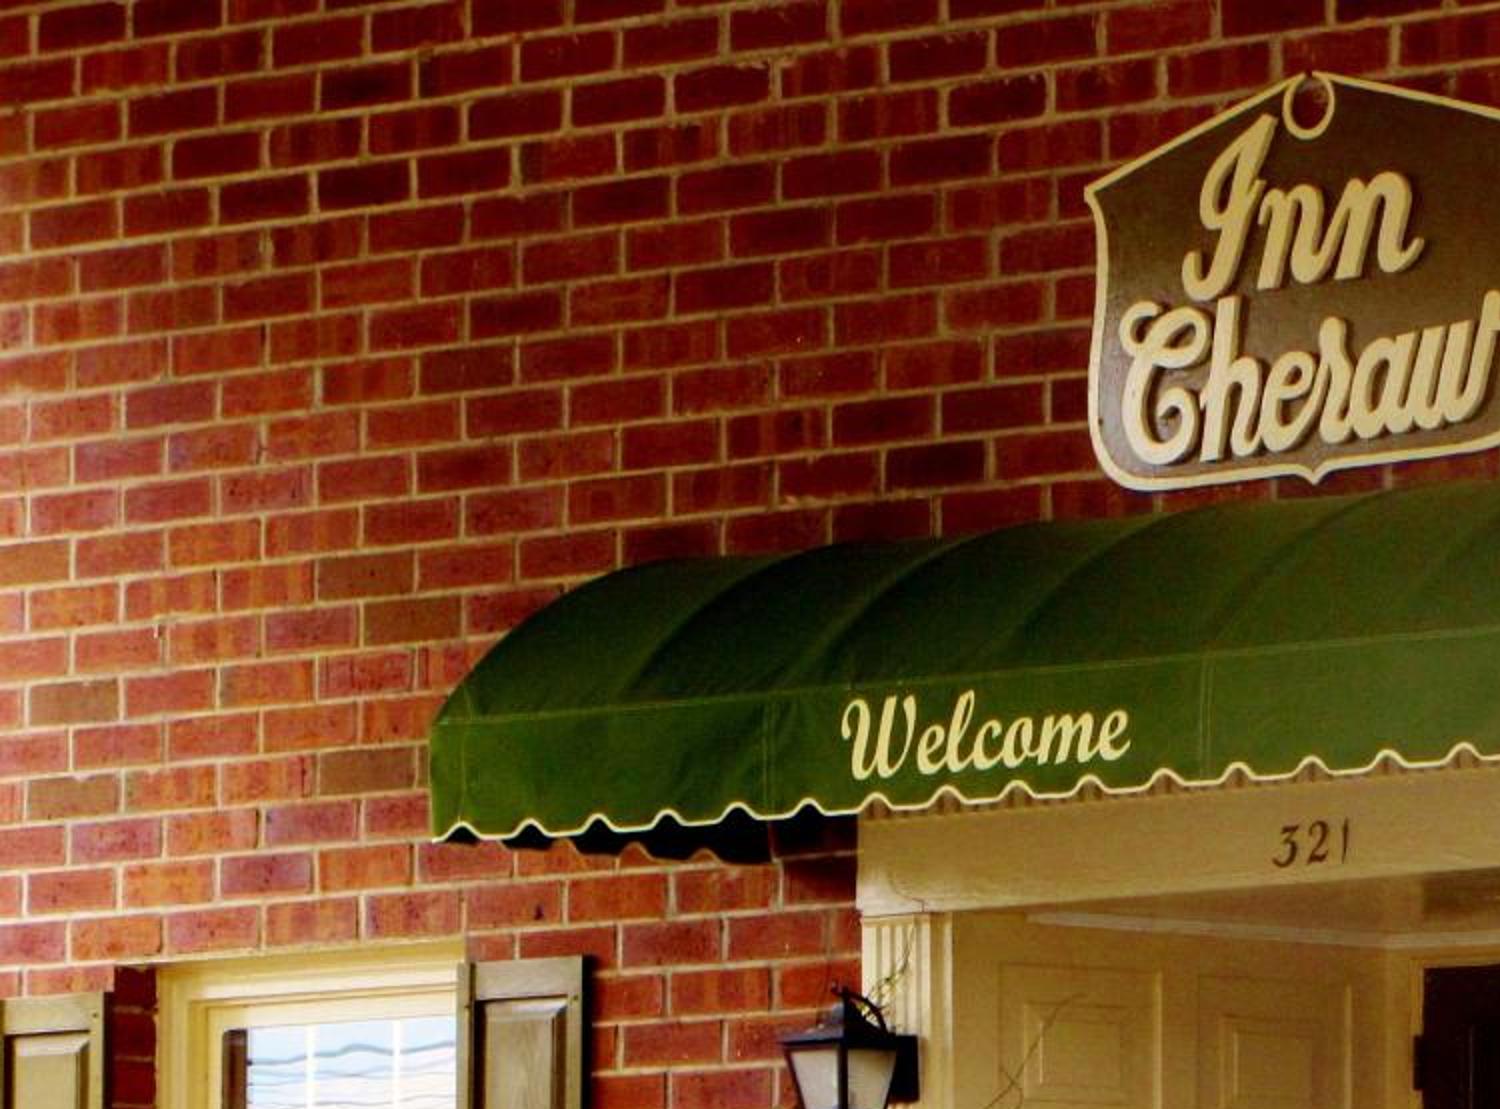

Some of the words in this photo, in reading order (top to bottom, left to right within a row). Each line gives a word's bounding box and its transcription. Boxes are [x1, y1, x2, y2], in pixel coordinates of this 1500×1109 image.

[1181, 113, 1424, 300] Inn
[841, 690, 1131, 780] Welcome
[1272, 816, 1349, 868] 321
